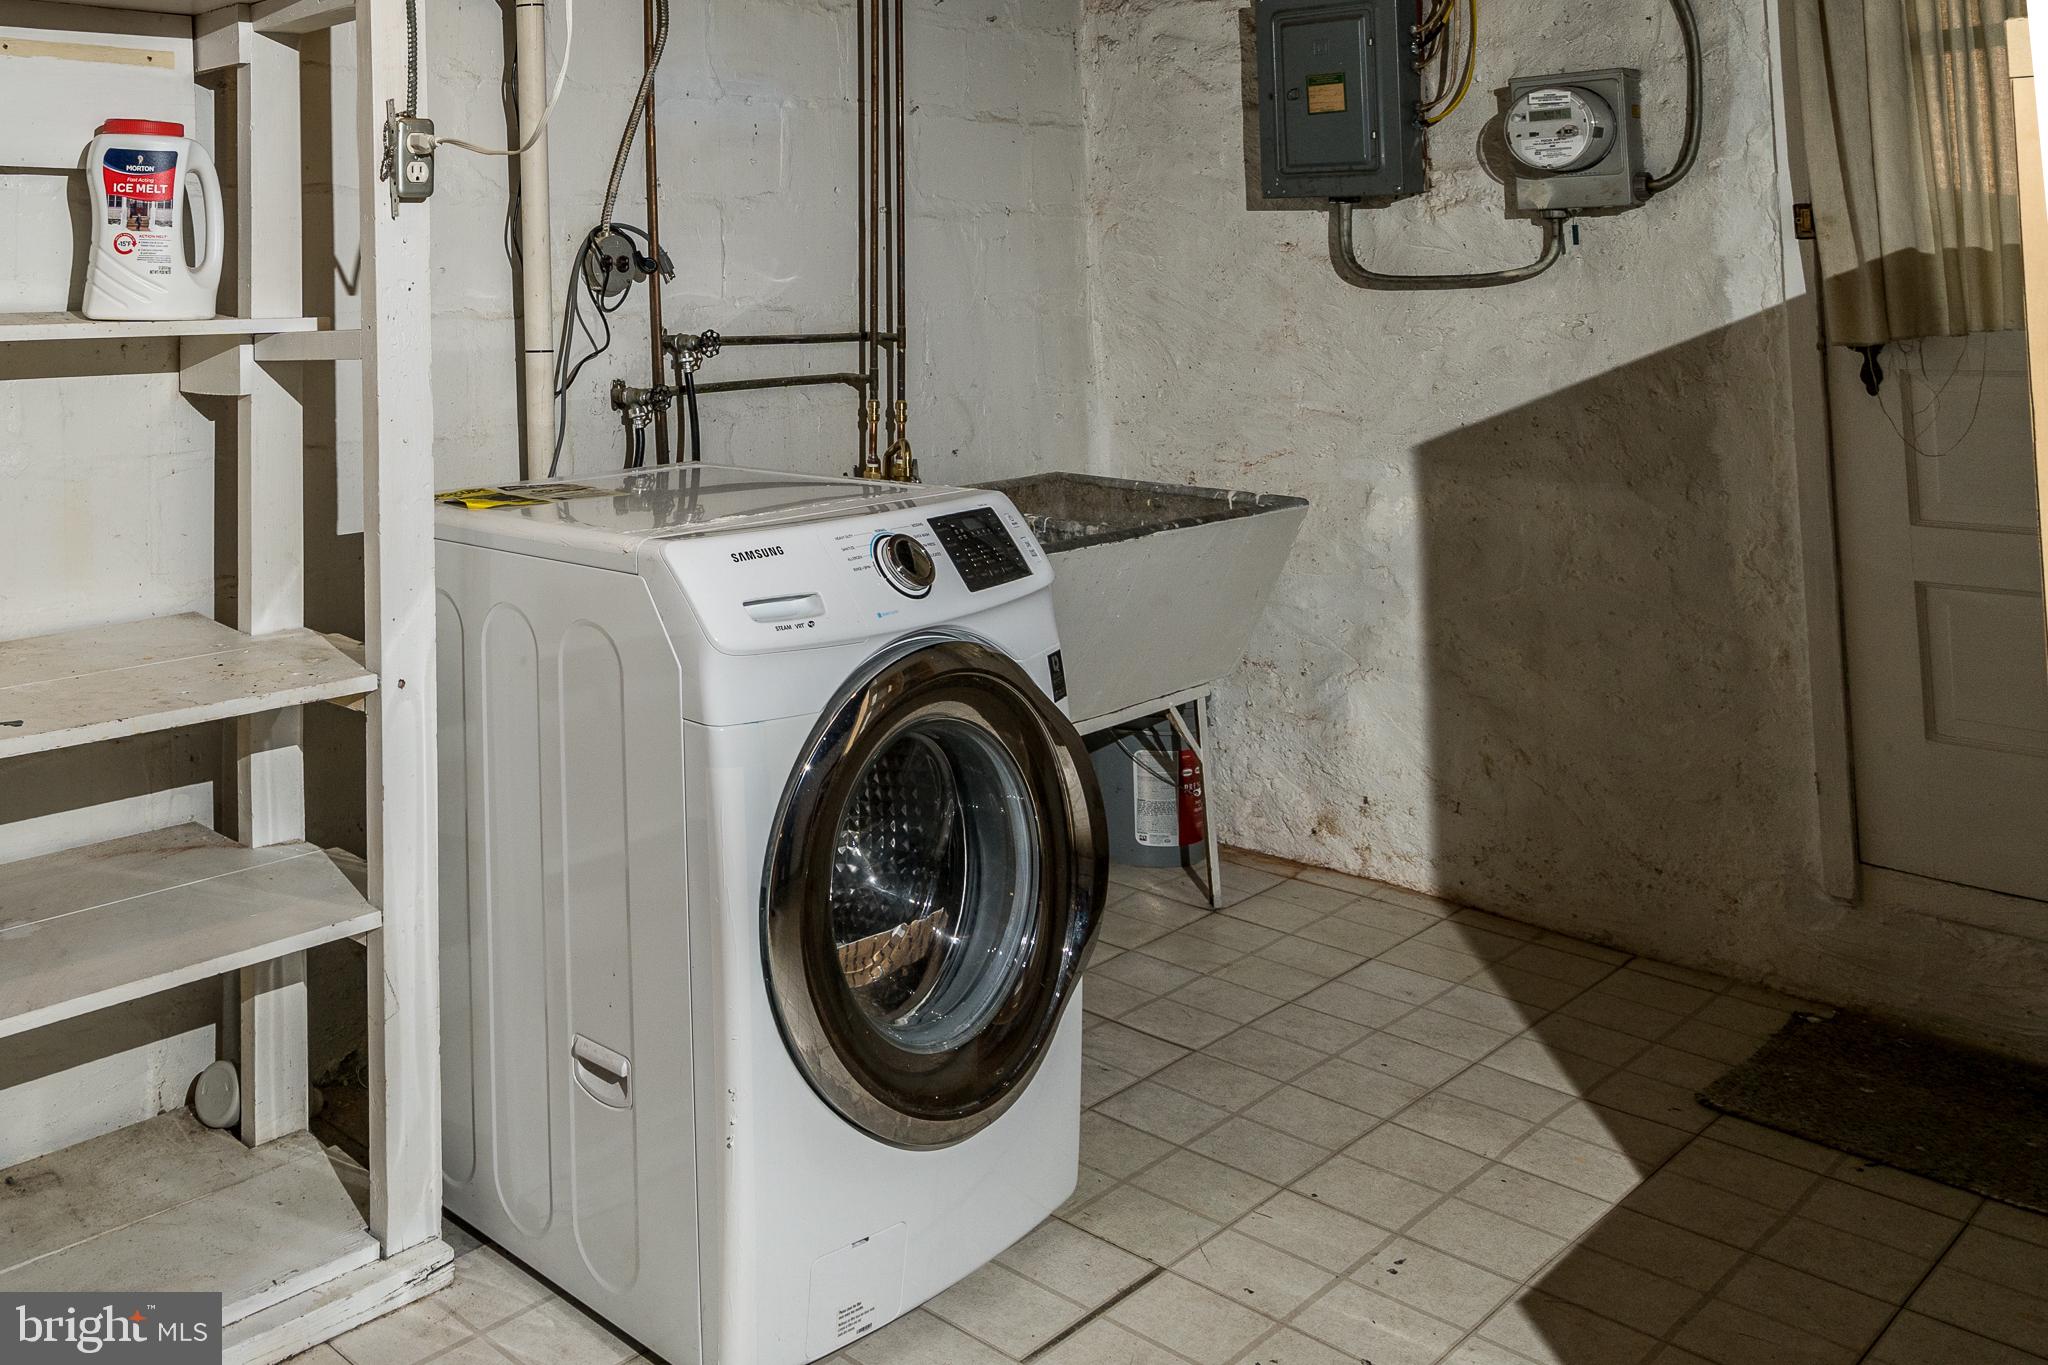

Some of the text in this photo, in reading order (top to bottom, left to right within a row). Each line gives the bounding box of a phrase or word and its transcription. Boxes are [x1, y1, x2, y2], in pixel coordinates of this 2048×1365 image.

[113, 183, 168, 194] ICE MELT
[730, 545, 784, 563] SAMSUNG
